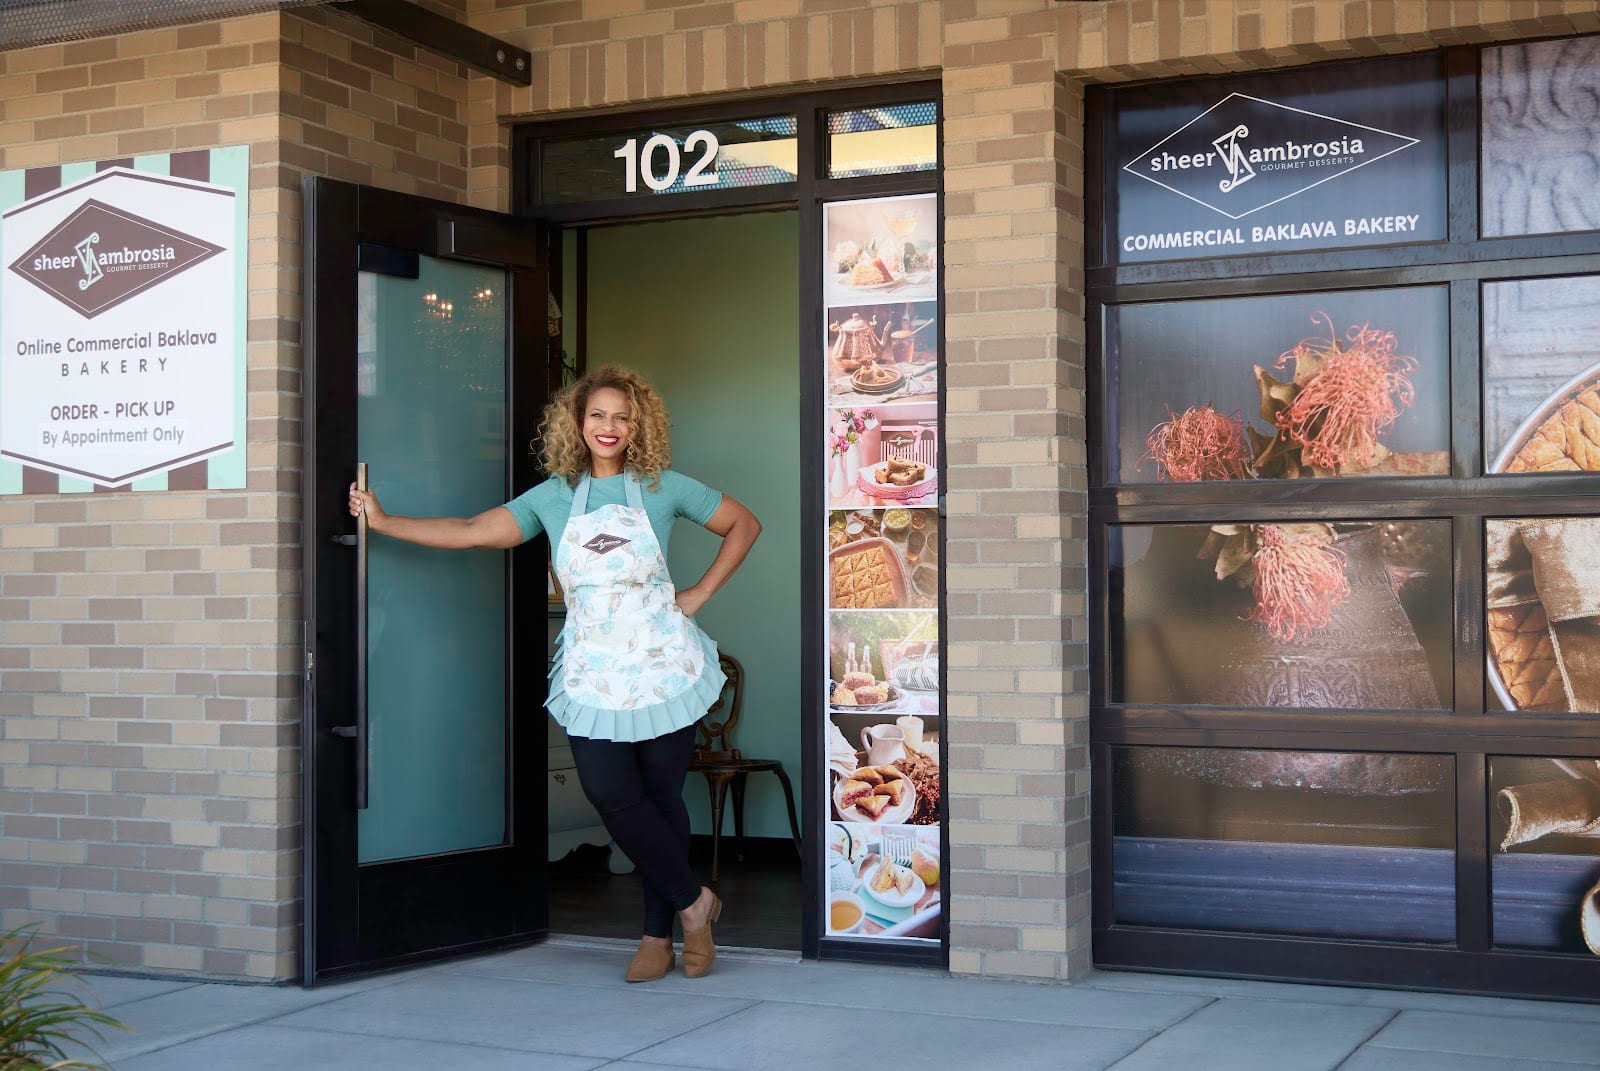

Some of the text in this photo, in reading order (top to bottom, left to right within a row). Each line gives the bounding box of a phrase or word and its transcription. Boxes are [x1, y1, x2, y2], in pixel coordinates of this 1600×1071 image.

[613, 129, 720, 193] 102
[1150, 135, 1364, 172] sheer ambrosia
[1260, 156, 1354, 172] GOURMET DESSERTS
[1123, 214, 1420, 252] COMMERCIAL BAKLAVA BAKERY
[34, 243, 176, 271] sheer ambrosia
[106, 262, 169, 273] GOURMET DESSERTS
[17, 330, 217, 356] Online Commercial Baklava
[61, 357, 167, 377] BAKERY
[50, 404, 98, 421] ORDER
[115, 402, 149, 418] PICK
[153, 400, 175, 416] UP
[42, 426, 185, 448] By Appointment Only
